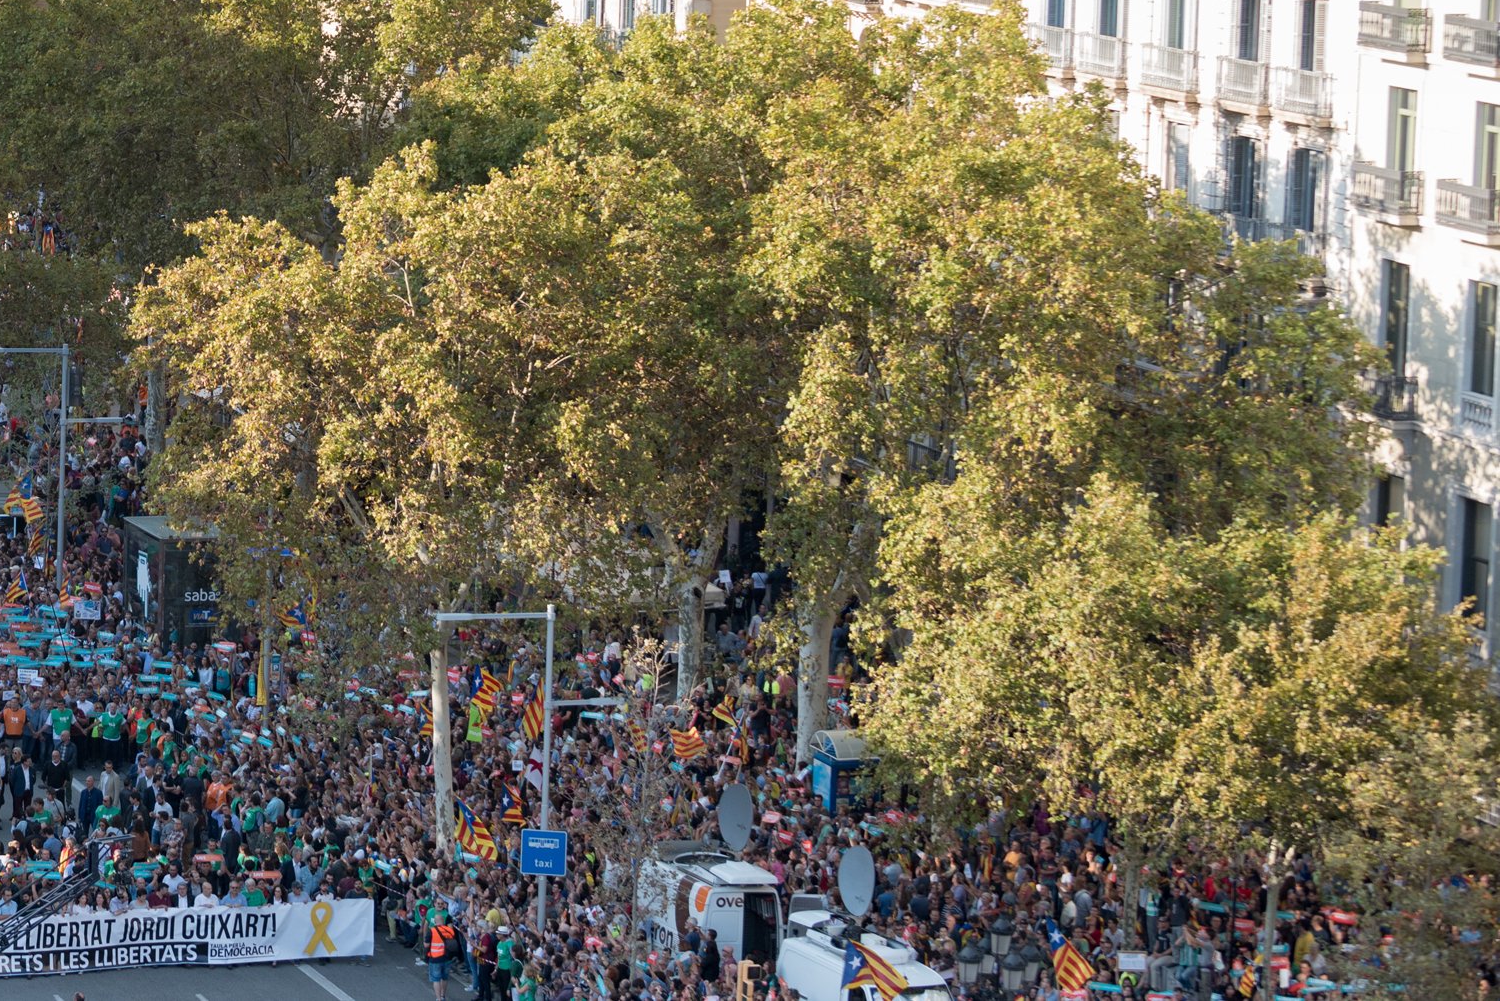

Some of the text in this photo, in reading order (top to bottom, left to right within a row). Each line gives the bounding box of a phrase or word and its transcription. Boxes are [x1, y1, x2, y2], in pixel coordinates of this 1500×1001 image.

[184, 588, 216, 602] saba
[534, 858, 553, 868] taxi
[120, 916, 175, 943] JORDI
[182, 912, 277, 940] CUIXART!
[50, 953, 55, 970] I
[60, 951, 89, 970] LES
[94, 944, 198, 966] LLIBERTATS
[210, 944, 274, 958] DEMOCRÀCIA
